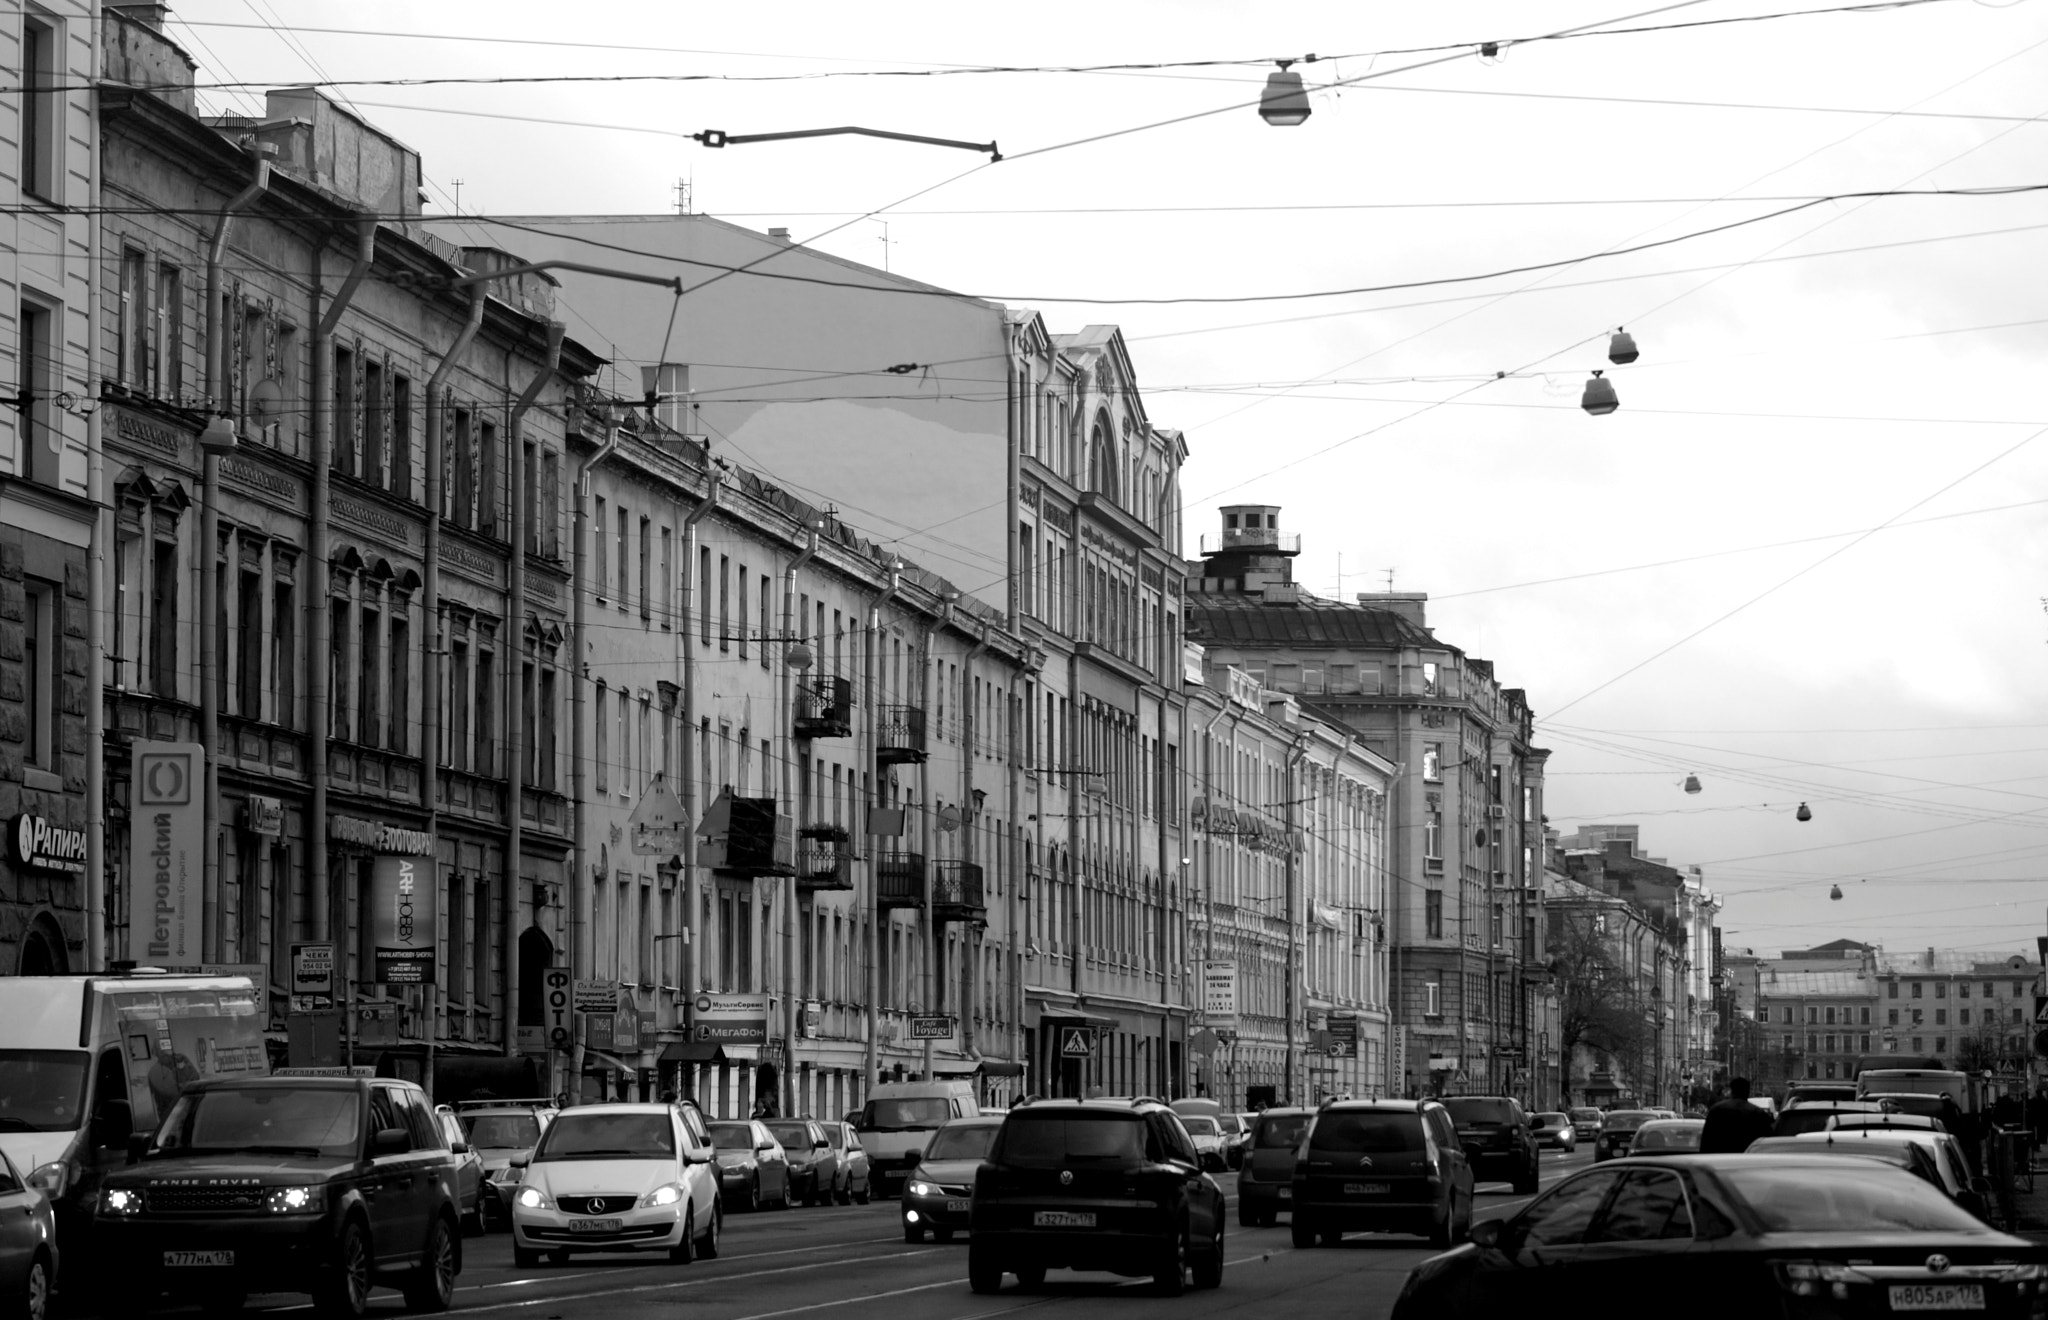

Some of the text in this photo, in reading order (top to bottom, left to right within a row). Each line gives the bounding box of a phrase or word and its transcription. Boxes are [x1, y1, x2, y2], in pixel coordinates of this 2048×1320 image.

[32, 816, 88, 860] РАПИРА
[383, 826, 433, 857] ЗООТОВАРЫ
[148, 812, 176, 957] Петровский
[547, 972, 568, 1044] ФОТО
[712, 1001, 764, 1009] МультиСервис
[915, 1025, 948, 1036] Voyage
[1394, 1026, 1402, 1093] СТОМАТОЛОГИЯ
[214, 1252, 232, 1262] 178
[1957, 1286, 1980, 1300] 178
